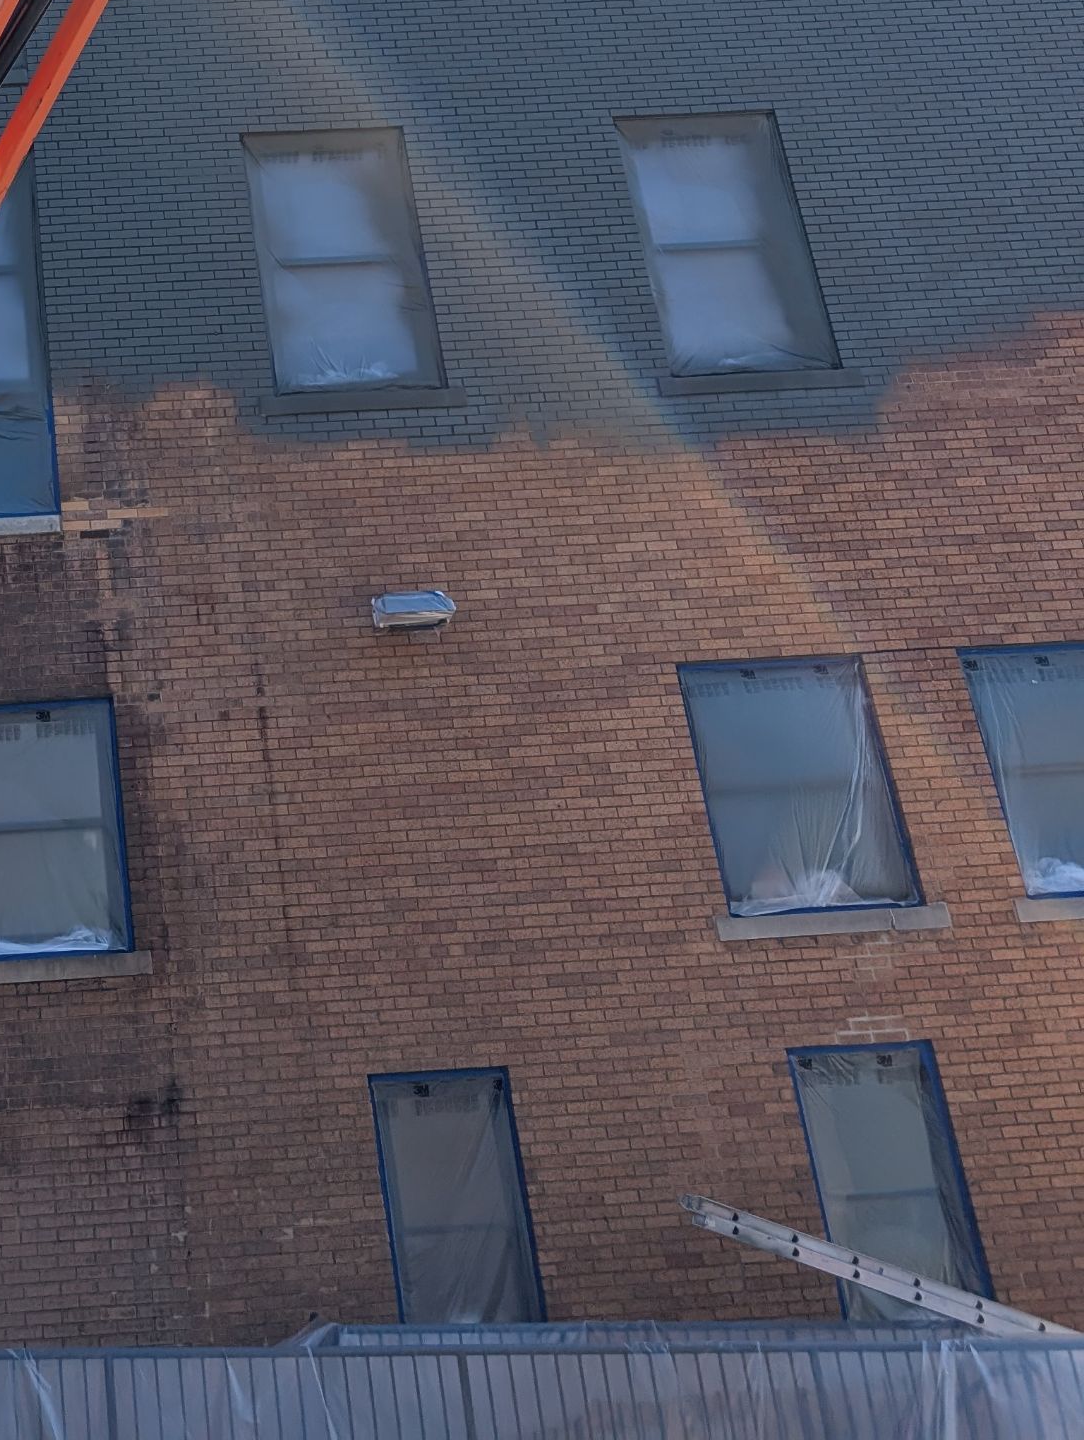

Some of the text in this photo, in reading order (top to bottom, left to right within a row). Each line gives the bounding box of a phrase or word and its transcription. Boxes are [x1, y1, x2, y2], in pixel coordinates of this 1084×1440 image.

[740, 668, 756, 680] 3M
[814, 664, 829, 675] 3M
[35, 711, 51, 722] 3M
[877, 1054, 893, 1067] 3M
[413, 1083, 430, 1097] 3M
